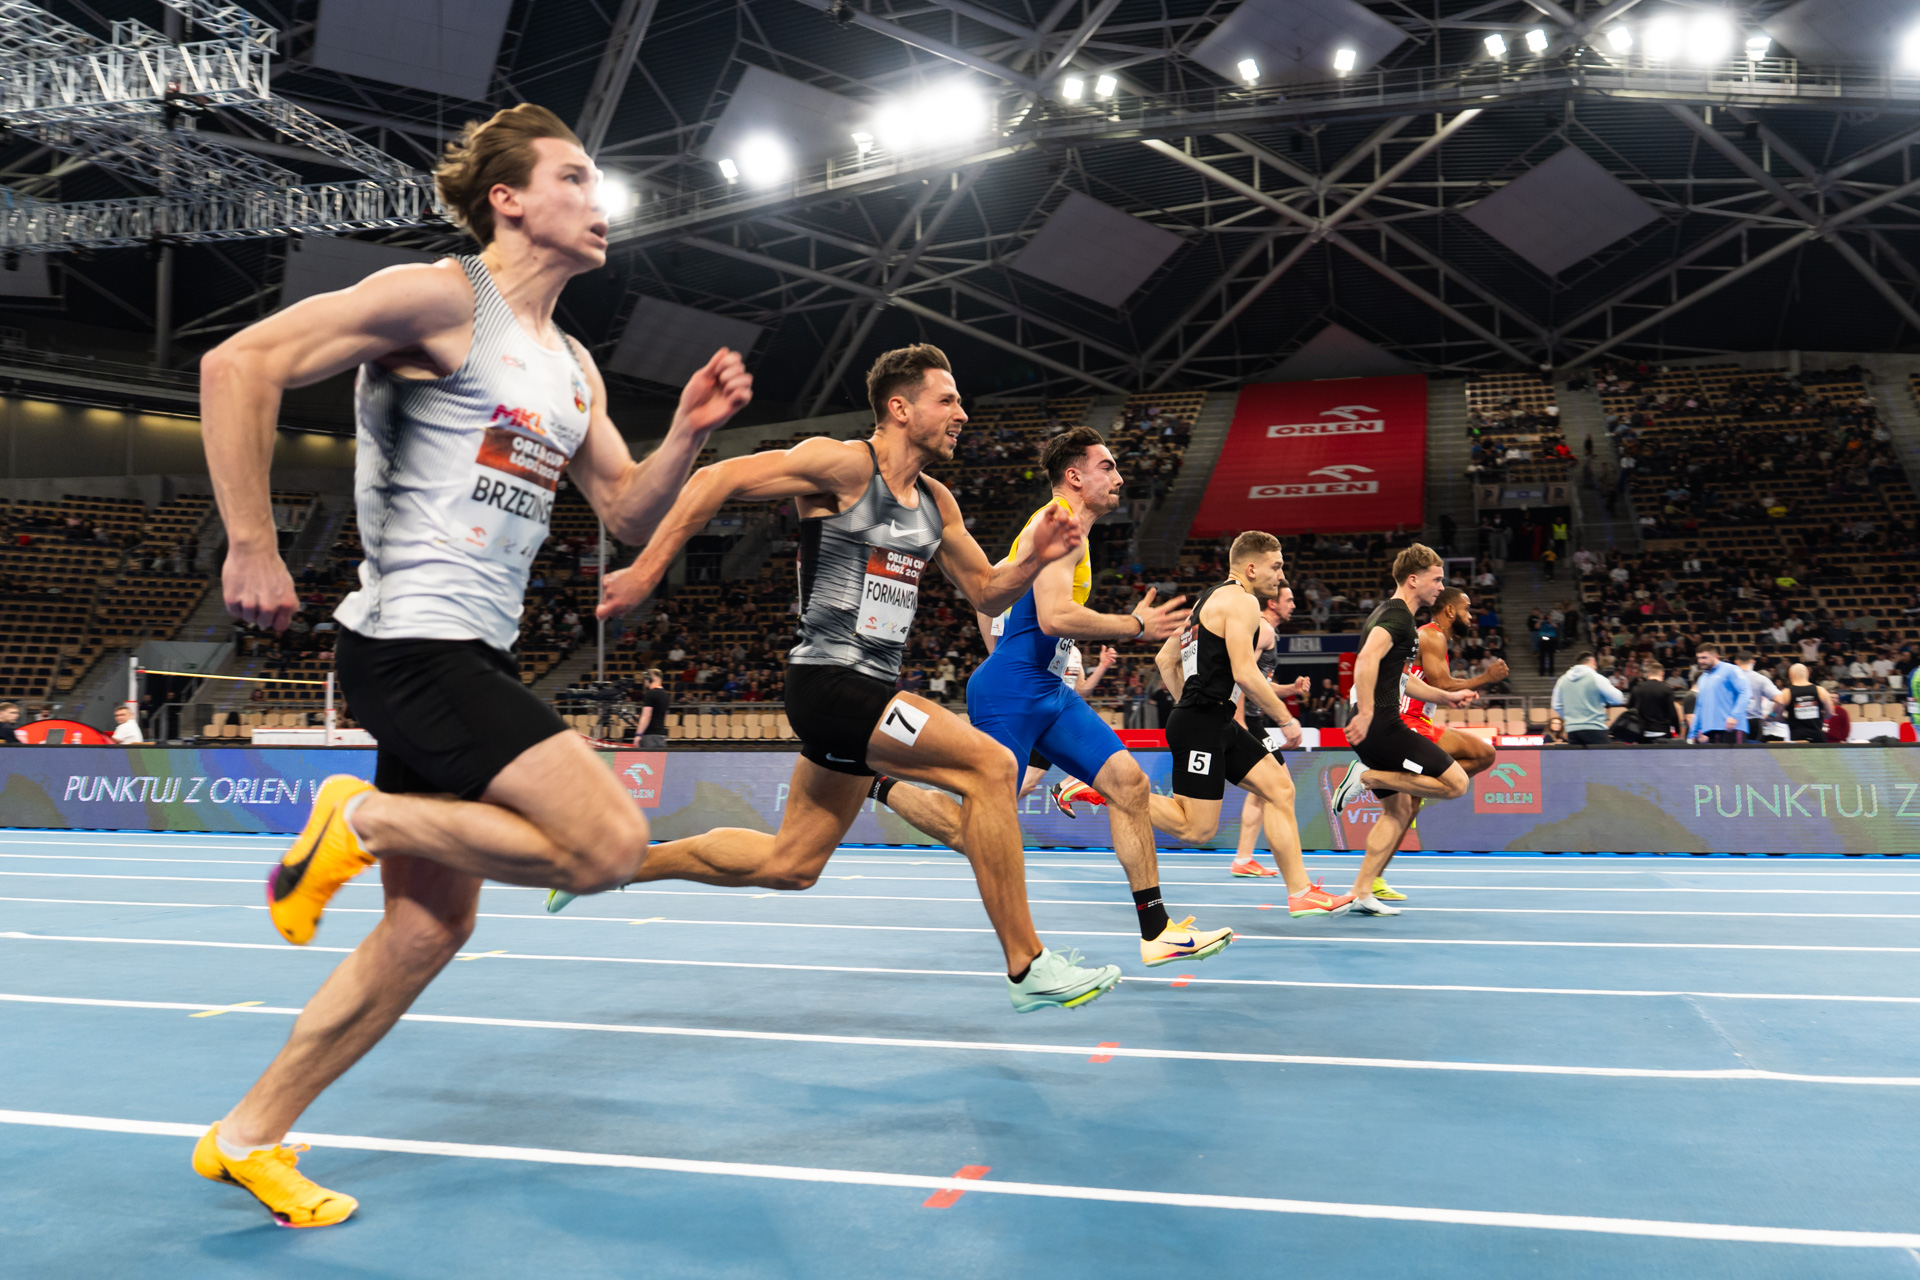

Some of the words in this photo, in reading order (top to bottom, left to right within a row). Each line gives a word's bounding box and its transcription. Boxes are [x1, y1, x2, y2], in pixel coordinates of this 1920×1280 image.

[490, 404, 547, 436] MKL
[1274, 422, 1376, 435] ORLEN
[1257, 483, 1370, 497] ORLEN
[887, 551, 913, 567] ORLEN
[885, 562, 905, 576] ŁÓDŹ
[886, 706, 917, 735] 7
[1267, 738, 1277, 750] 2
[1192, 753, 1206, 772] 5
[64, 775, 182, 803] PUNKTUJ
[182, 776, 207, 803] Z
[210, 776, 303, 805] ORLEN
[1484, 792, 1533, 804] ORLEN
[1694, 784, 1878, 818] PUNKTUJ
[1895, 784, 1920, 817] Z
